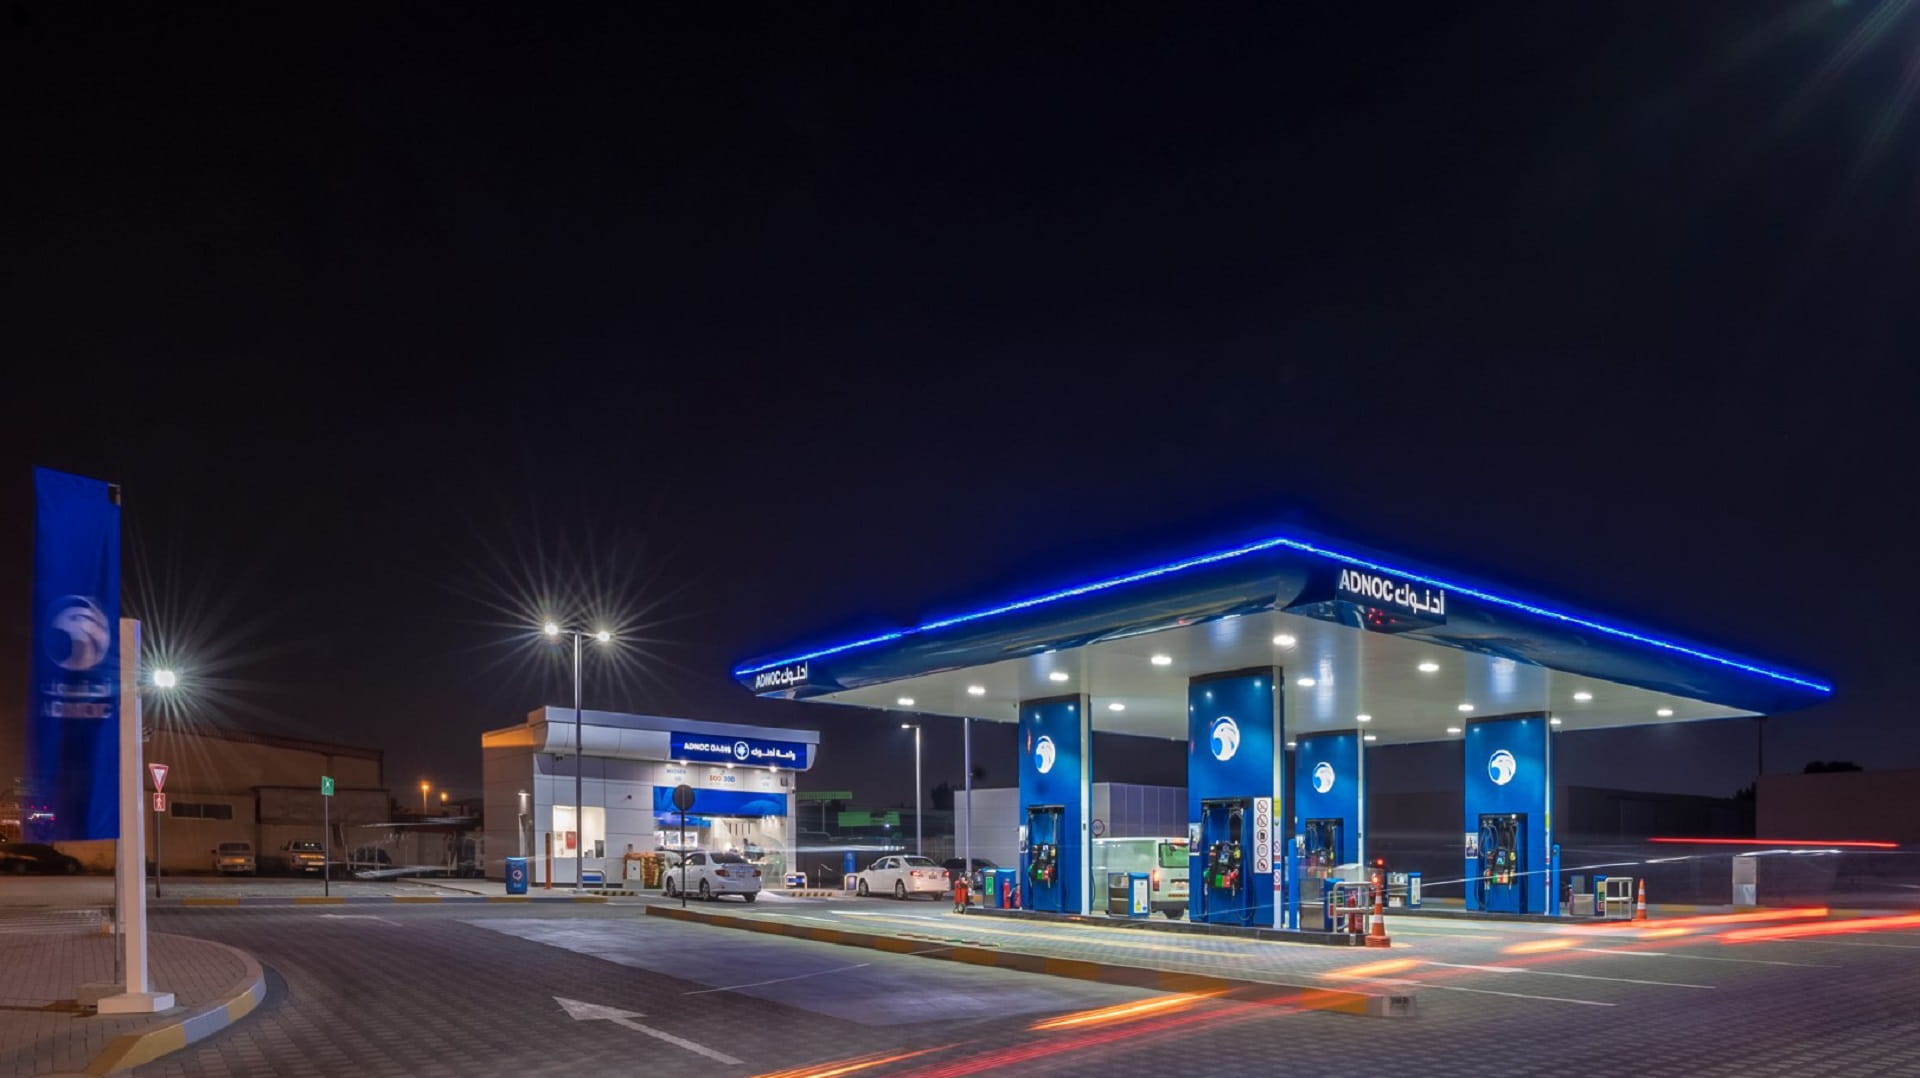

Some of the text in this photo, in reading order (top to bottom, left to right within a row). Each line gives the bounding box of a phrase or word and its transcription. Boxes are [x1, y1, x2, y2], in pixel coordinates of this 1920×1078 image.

[1339, 569, 1393, 601] ADNOC
[756, 670, 780, 688] ADNOC
[683, 742, 709, 751] ADNOC
